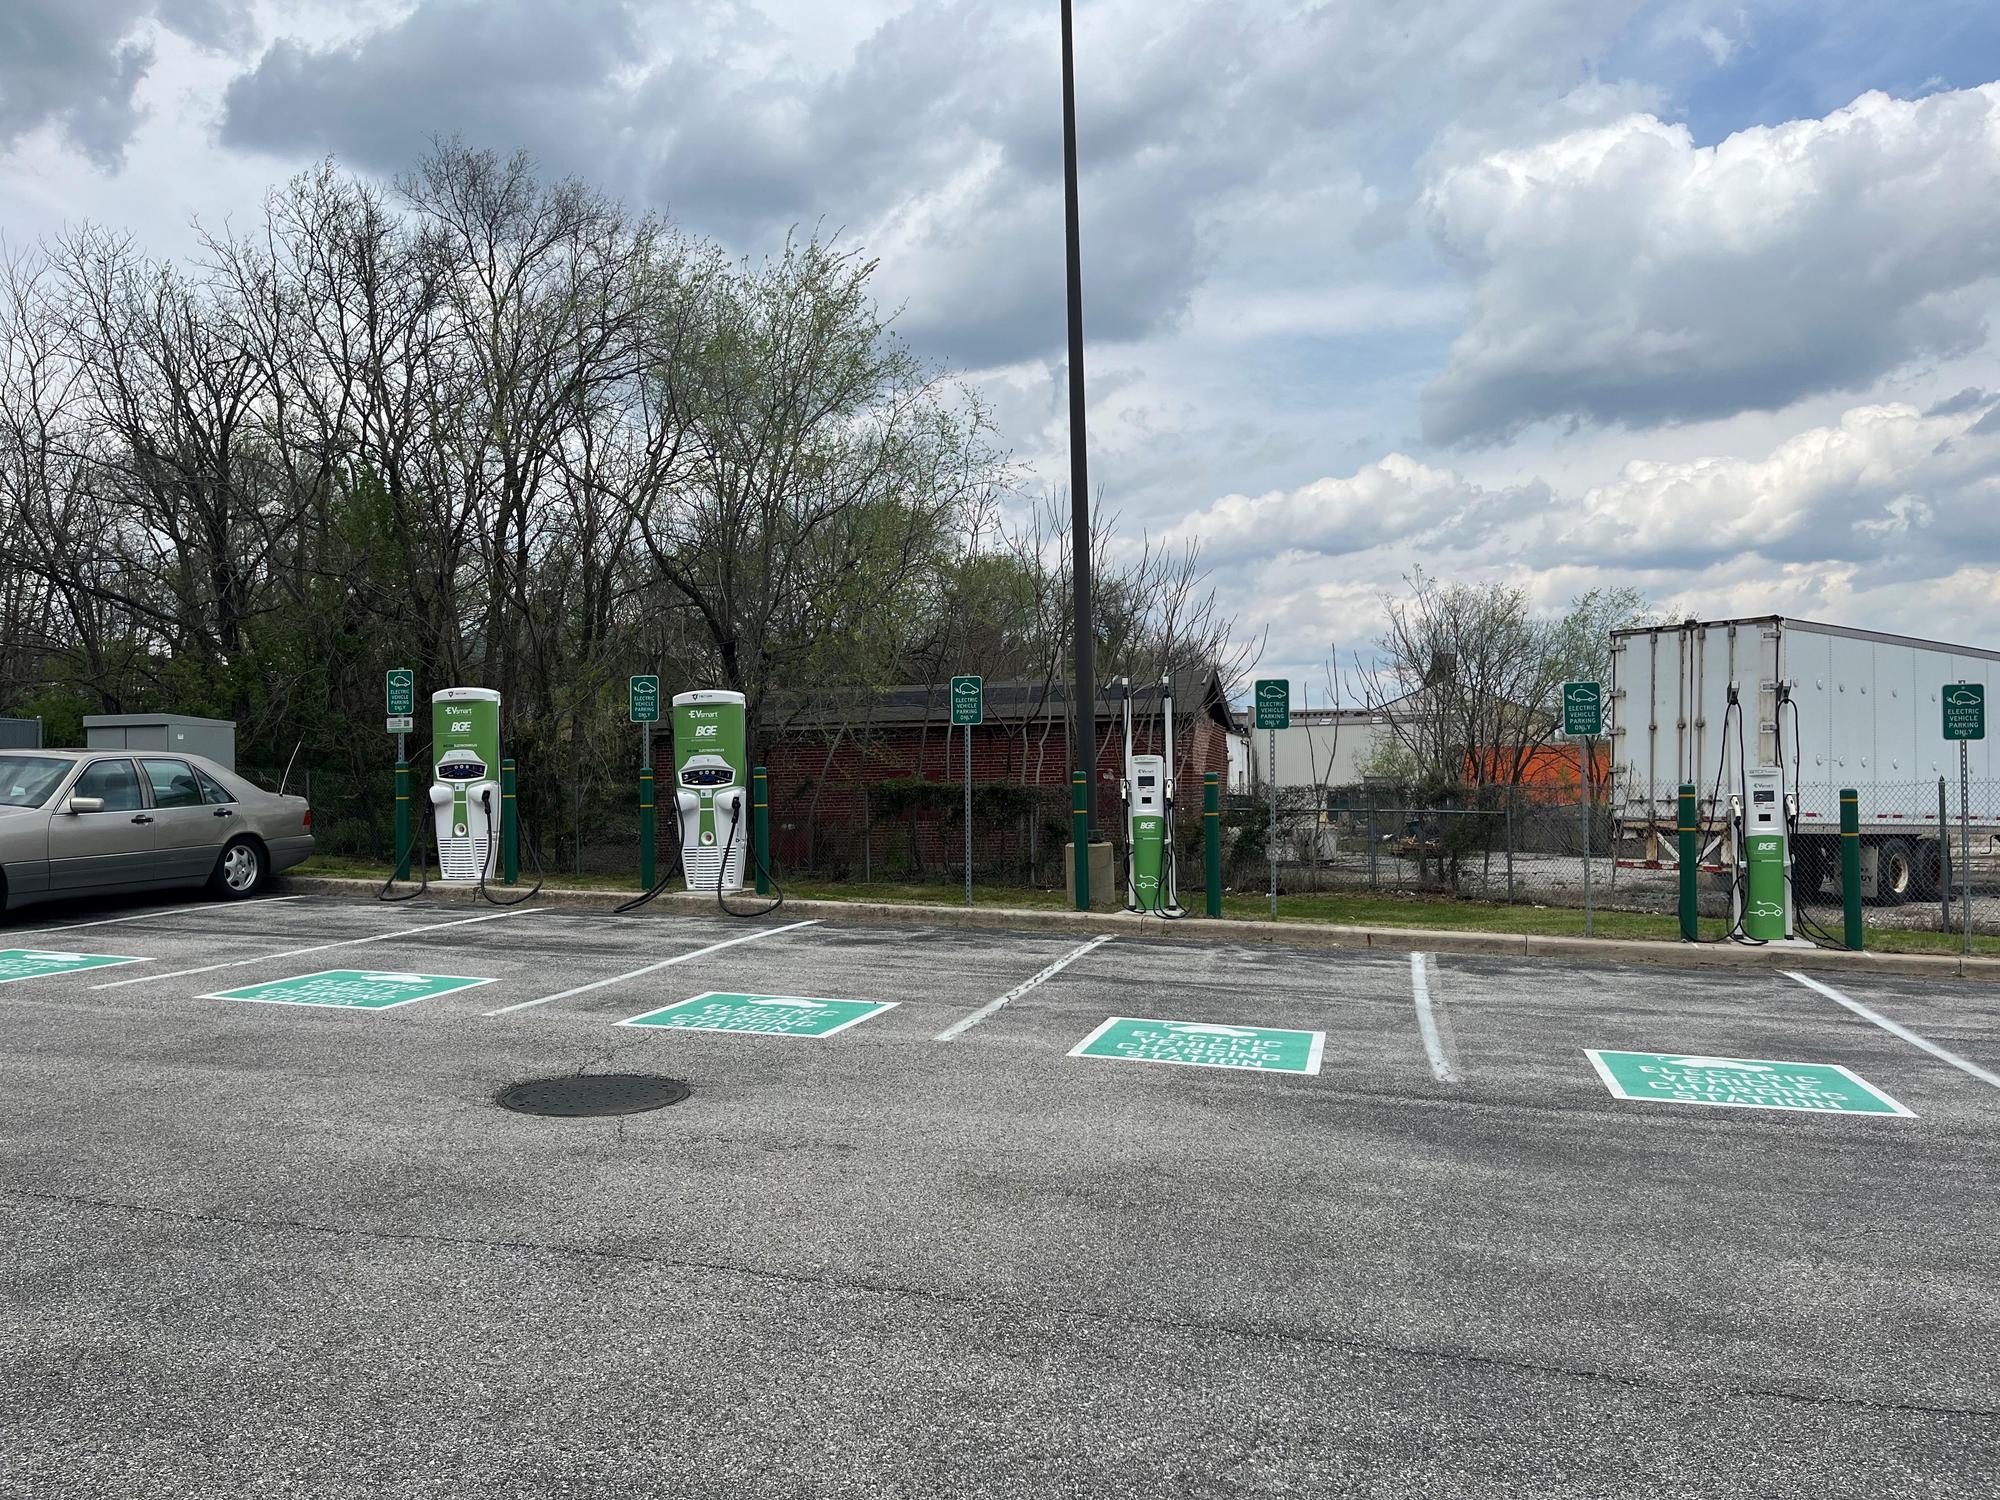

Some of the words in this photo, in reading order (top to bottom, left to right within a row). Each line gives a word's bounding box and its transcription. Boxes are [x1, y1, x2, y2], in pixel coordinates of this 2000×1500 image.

[451, 722, 471, 732] BGE
[695, 726, 718, 736] BGE
[1758, 842, 1776, 850] BGE
[702, 1003, 840, 1016] ELECTRIC
[704, 1010, 817, 1021] VEHICLE
[667, 1020, 792, 1032] STATION
[671, 1014, 818, 1027] CHARGING
[1131, 1031, 1284, 1047] ELECTRIC
[1140, 1038, 1266, 1053] VEHICLE
[1116, 1043, 1280, 1061] CHARGING
[1125, 1050, 1262, 1067] STATION
[1639, 1066, 1823, 1083] ELECTRIC
[1658, 1074, 1815, 1091] VEHICLE
[1648, 1082, 1848, 1101] CHARGING
[1672, 1091, 1842, 1109] STATION
